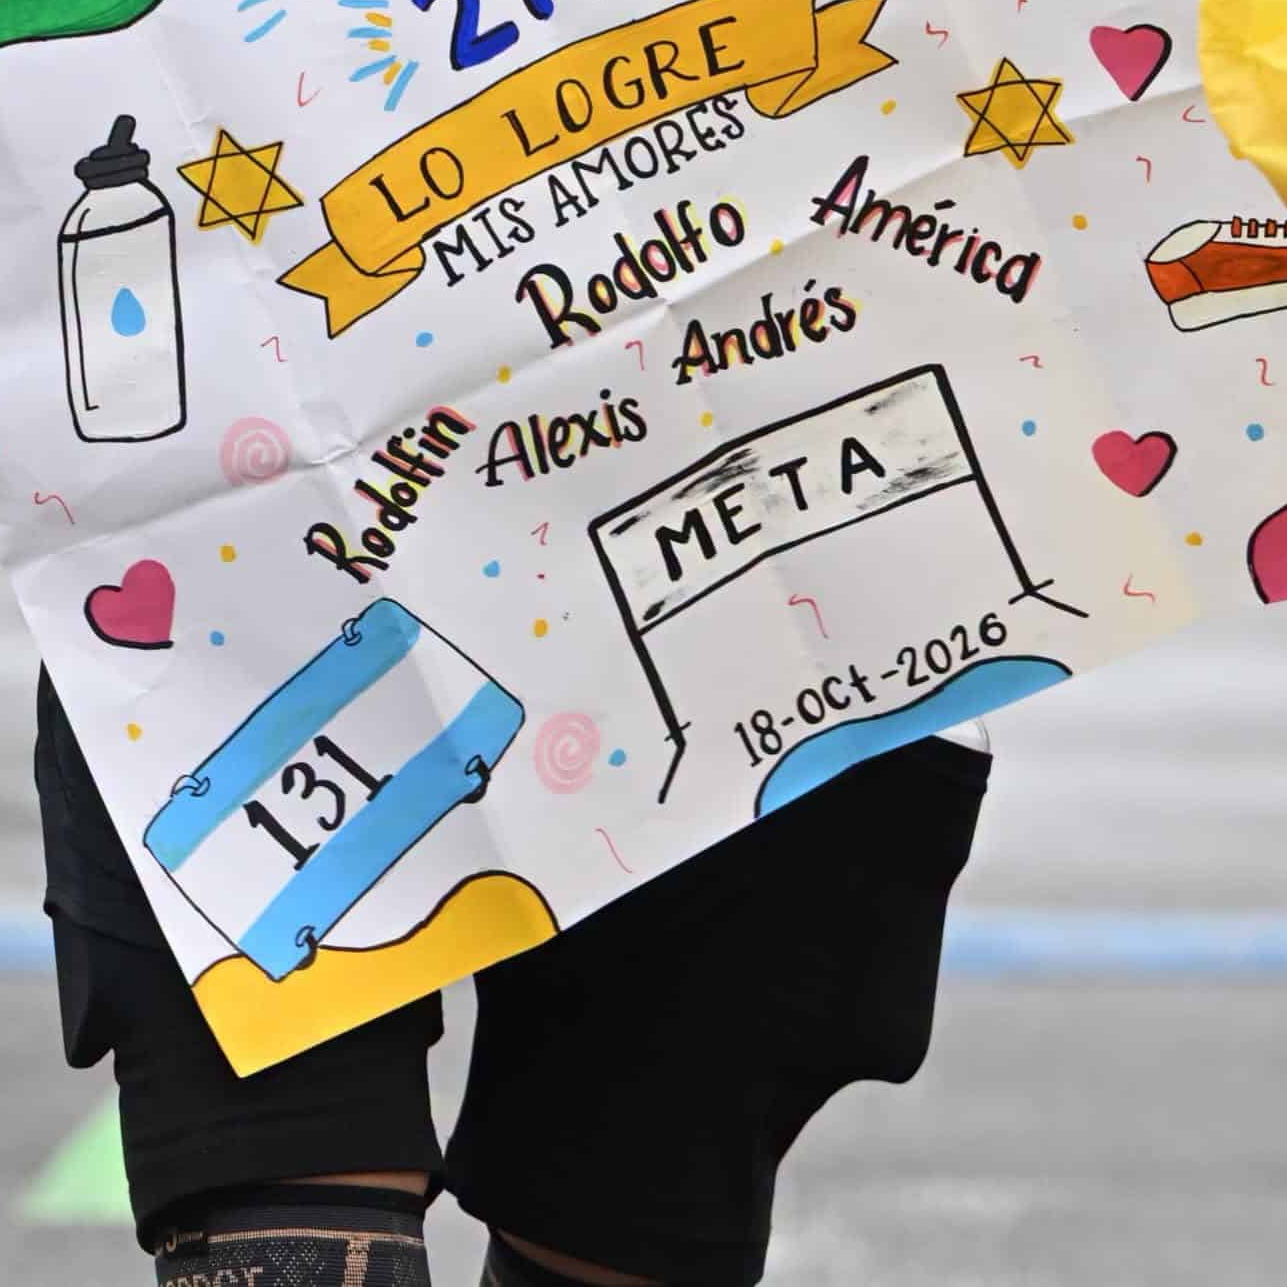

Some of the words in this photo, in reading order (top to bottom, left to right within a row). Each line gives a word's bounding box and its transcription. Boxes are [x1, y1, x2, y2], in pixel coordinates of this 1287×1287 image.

[369, 148, 464, 225] LO
[501, 16, 745, 158] LOGRE
[432, 197, 536, 286] MIS
[547, 98, 747, 227] AMORES
[516, 195, 746, 350] Rodolfo
[813, 155, 1042, 303] América
[674, 279, 860, 385] Andrés
[475, 389, 648, 487] Alexis
[654, 437, 886, 583] META
[242, 733, 394, 871] 131
